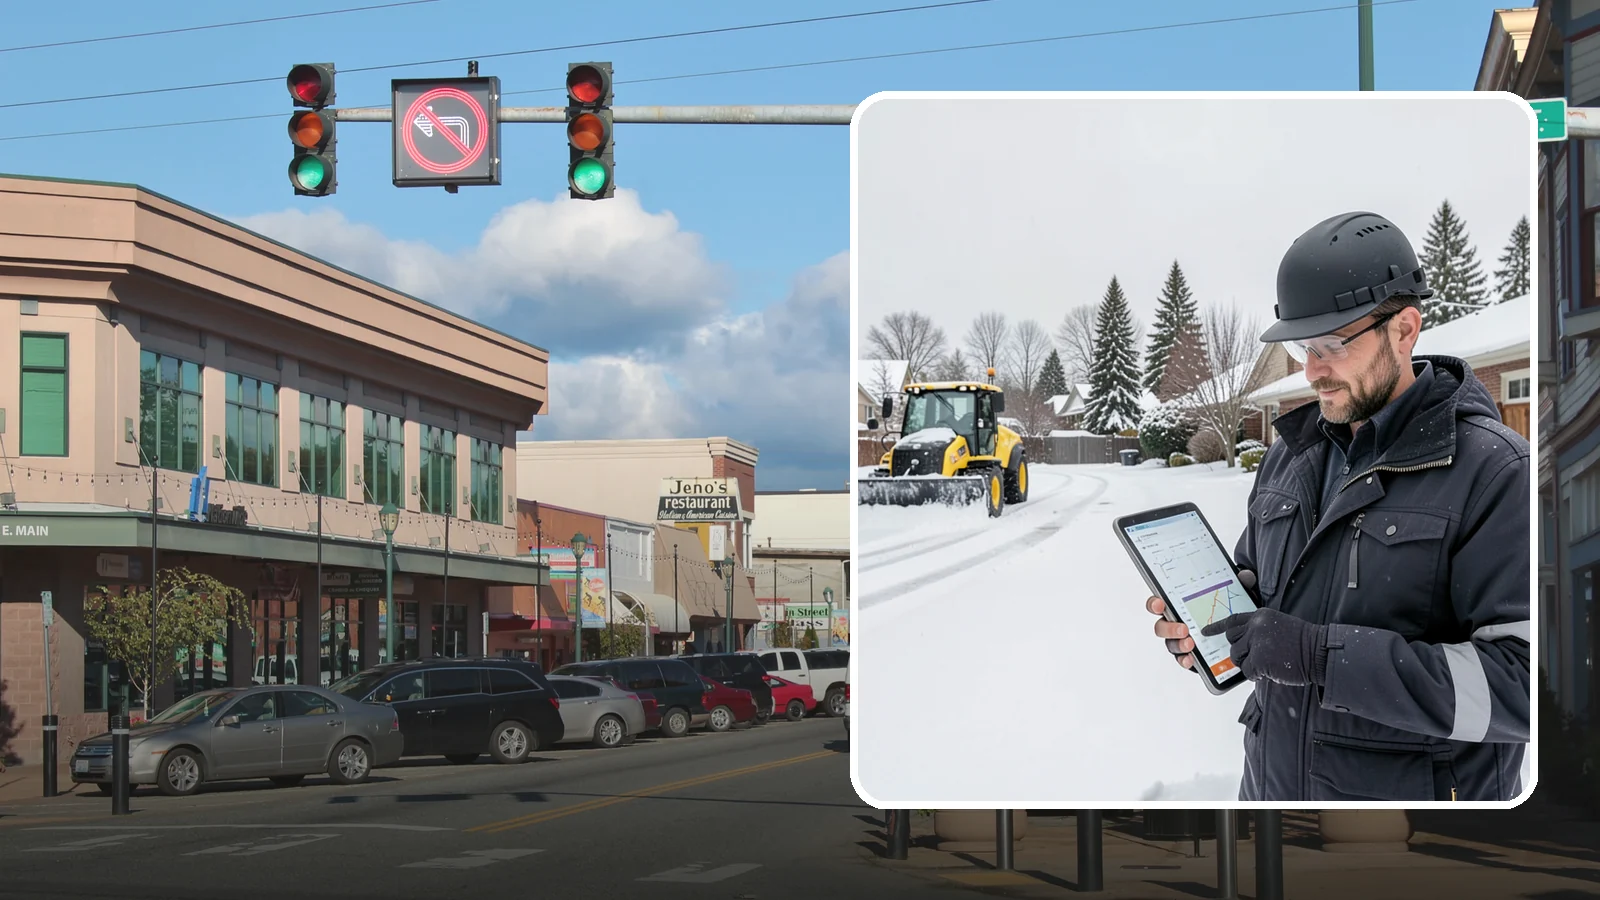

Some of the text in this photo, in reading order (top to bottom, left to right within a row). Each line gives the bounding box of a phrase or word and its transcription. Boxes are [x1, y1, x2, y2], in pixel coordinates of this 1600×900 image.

[670, 480, 727, 494] Jeno's
[665, 497, 730, 508] restaurant
[659, 510, 681, 519] Italian
[686, 510, 714, 519] American
[715, 509, 737, 519] Cuisine
[2, 525, 48, 536] E. MAIN
[786, 608, 795, 616] in
[798, 608, 828, 616] Street
[791, 619, 824, 627] lass
